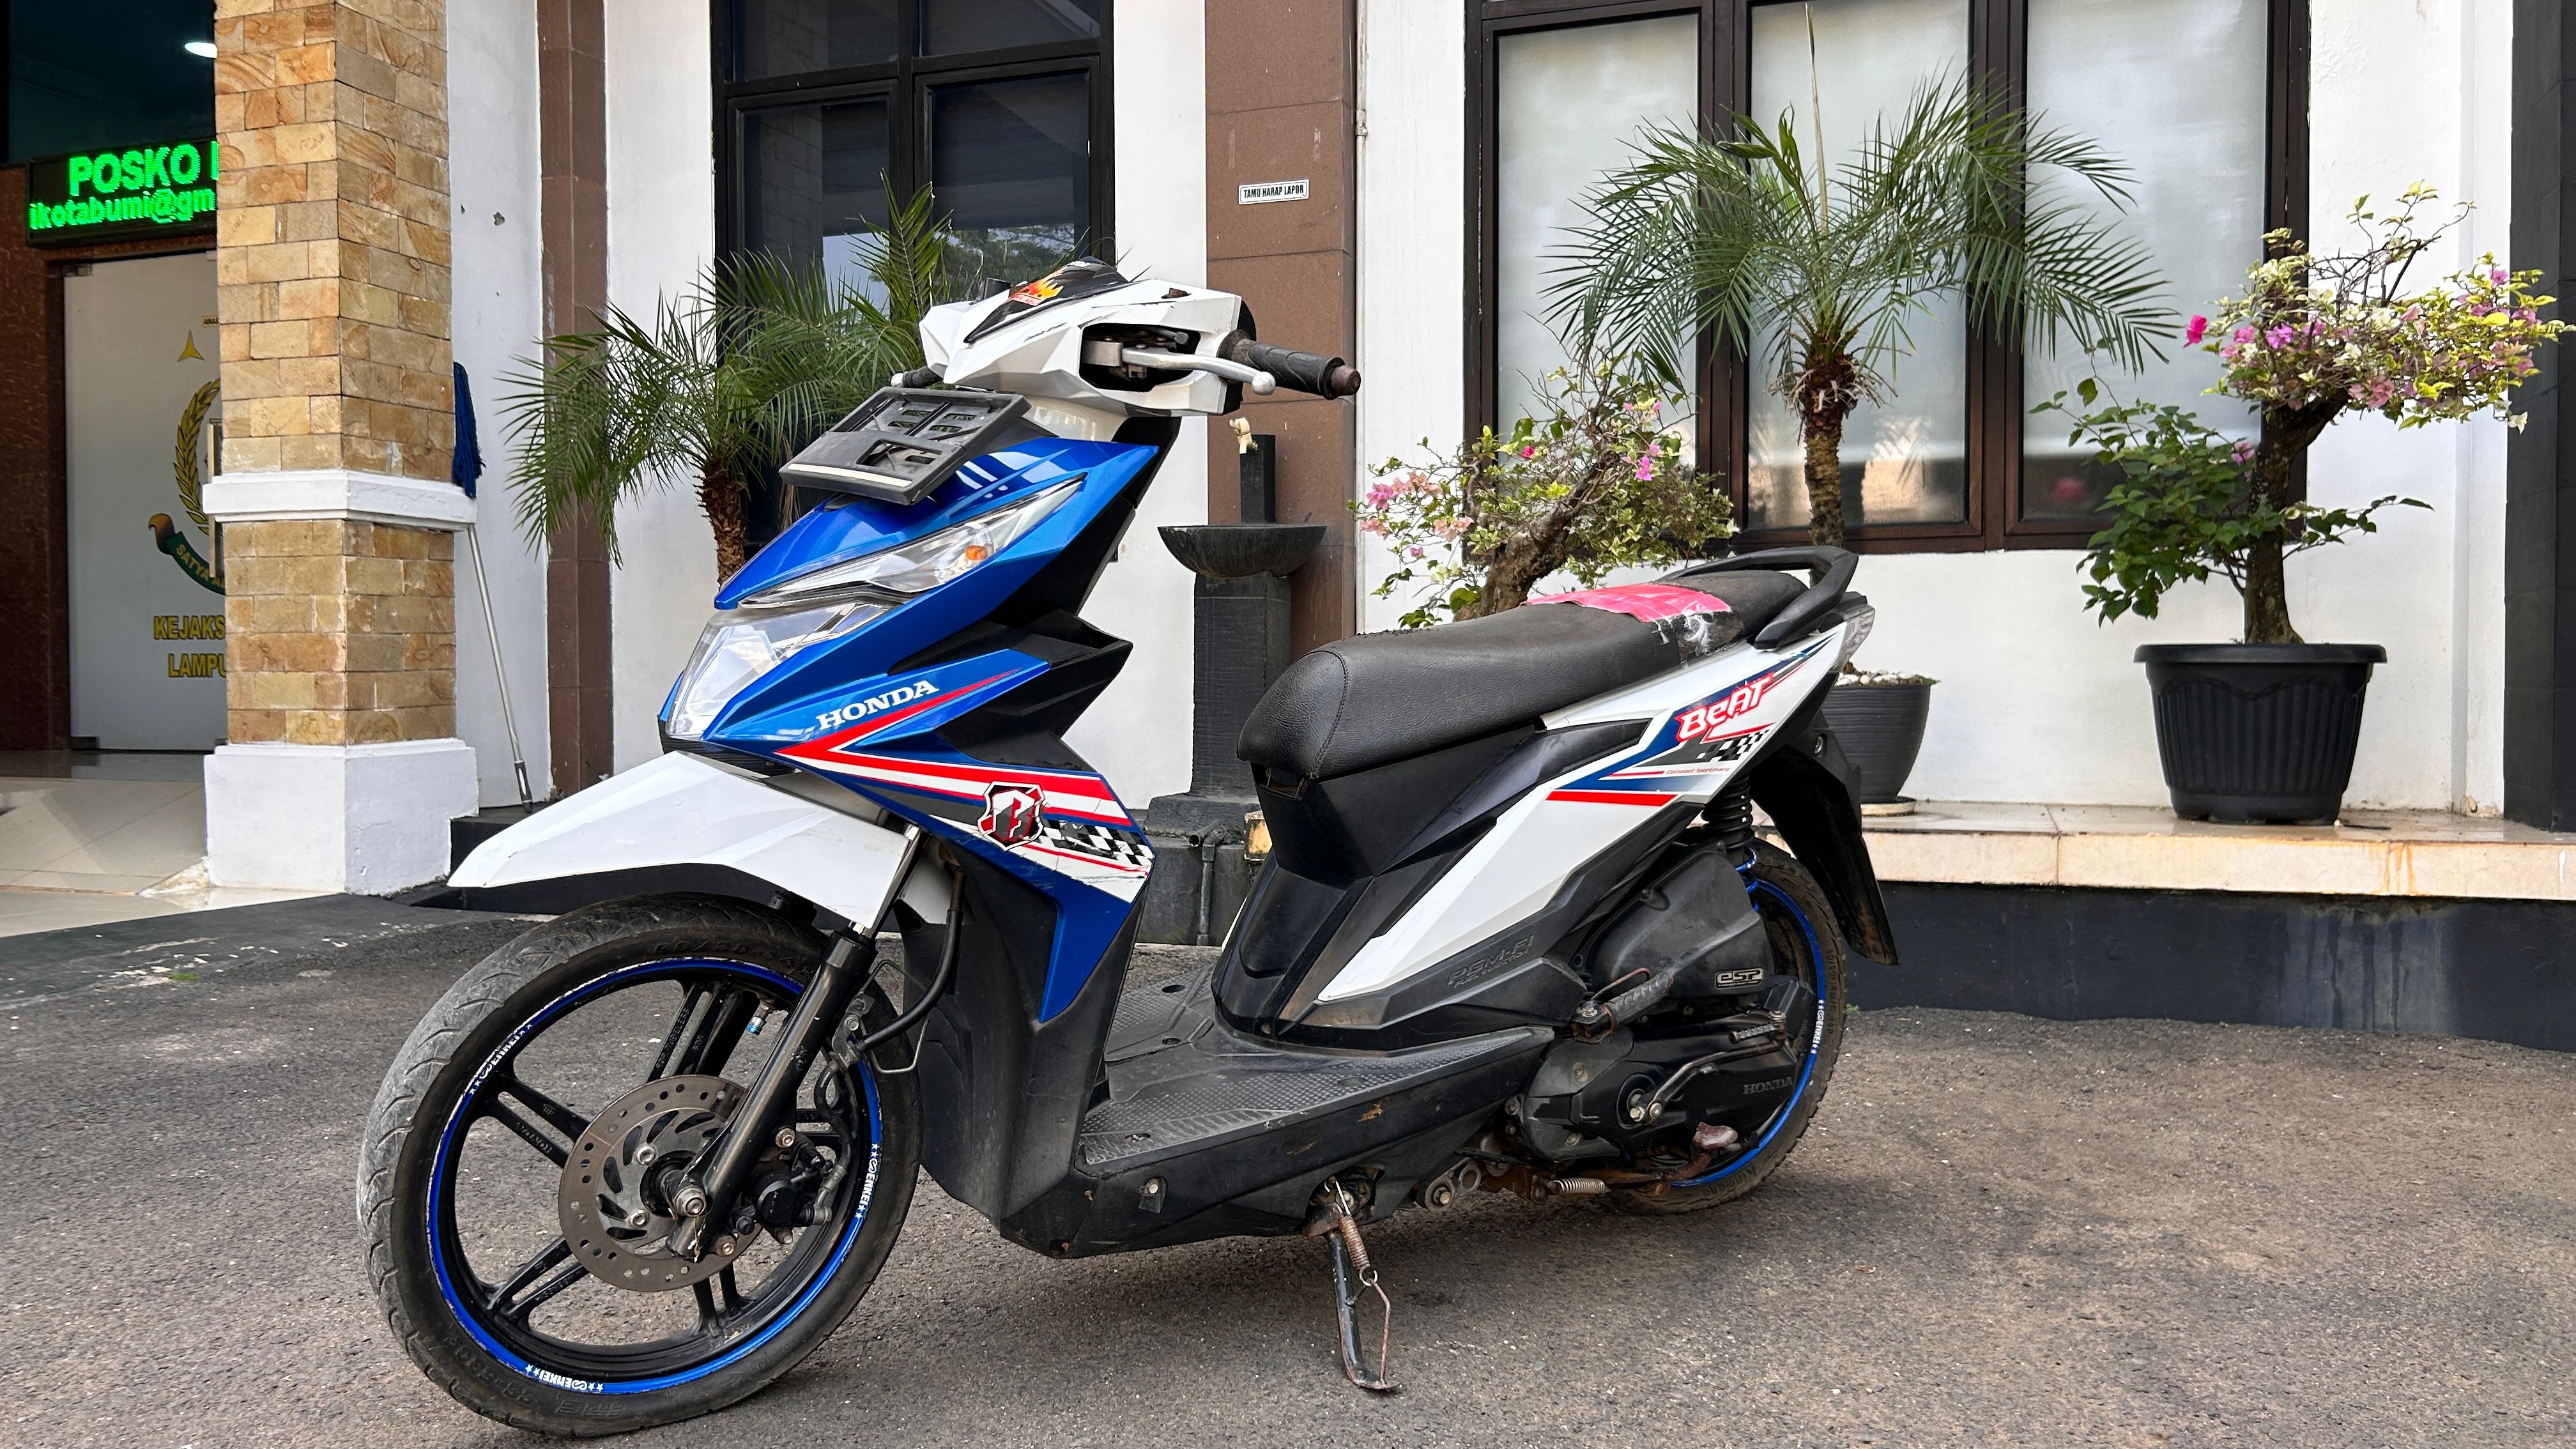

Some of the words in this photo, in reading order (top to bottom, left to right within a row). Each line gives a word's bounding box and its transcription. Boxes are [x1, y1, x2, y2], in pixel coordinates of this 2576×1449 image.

[69, 144, 201, 196] POSKO
[1243, 188, 1261, 198] TAMU
[1262, 187, 1283, 197] HARAP
[1284, 185, 1304, 195] LAPOR
[176, 544, 210, 581] SATYA
[153, 615, 226, 640] KEJAKS
[815, 680, 940, 730] HONDA
[1743, 1077, 1793, 1094] HONDA
